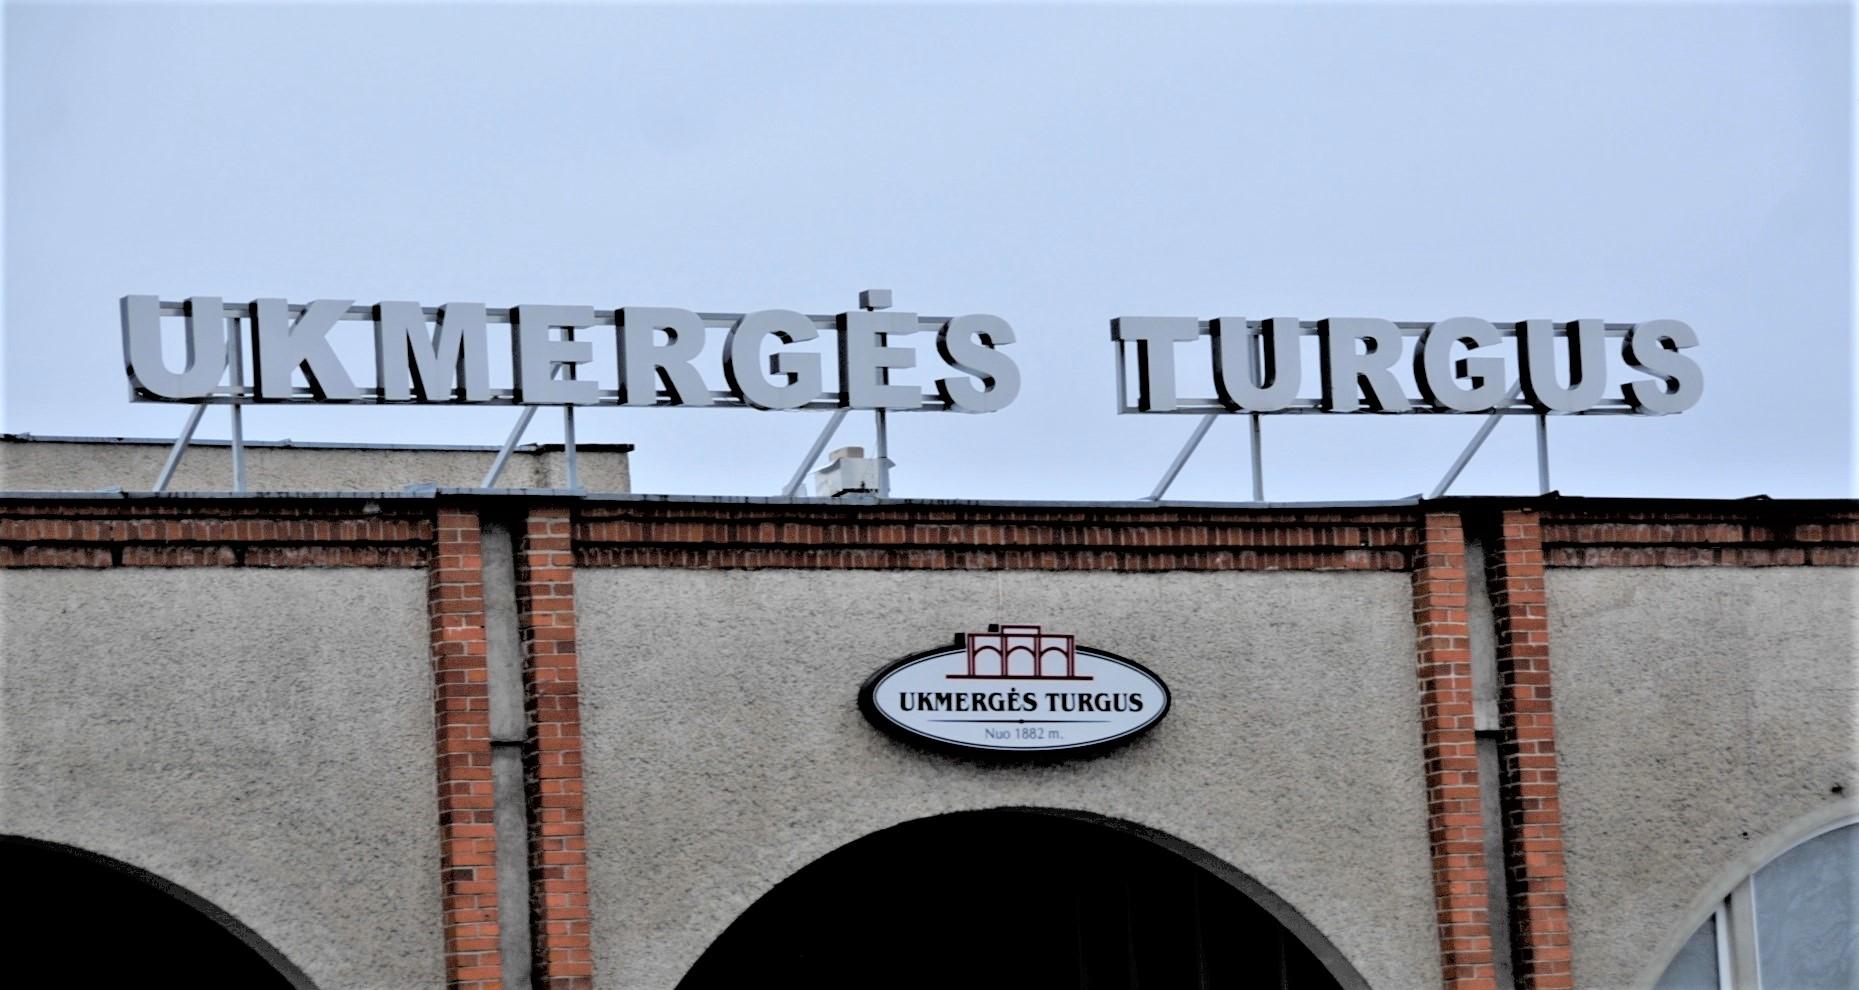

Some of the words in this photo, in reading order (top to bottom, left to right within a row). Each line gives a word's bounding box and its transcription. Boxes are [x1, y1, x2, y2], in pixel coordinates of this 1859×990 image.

[120, 289, 1021, 414] UKMERGĖS
[1111, 316, 1704, 416] TURGUS
[899, 688, 1038, 712] UKMERGĖS
[1045, 692, 1143, 713] TURGUS
[985, 728, 1011, 740] Nuo
[1015, 728, 1044, 740] 1882
[1048, 730, 1064, 740] m.
